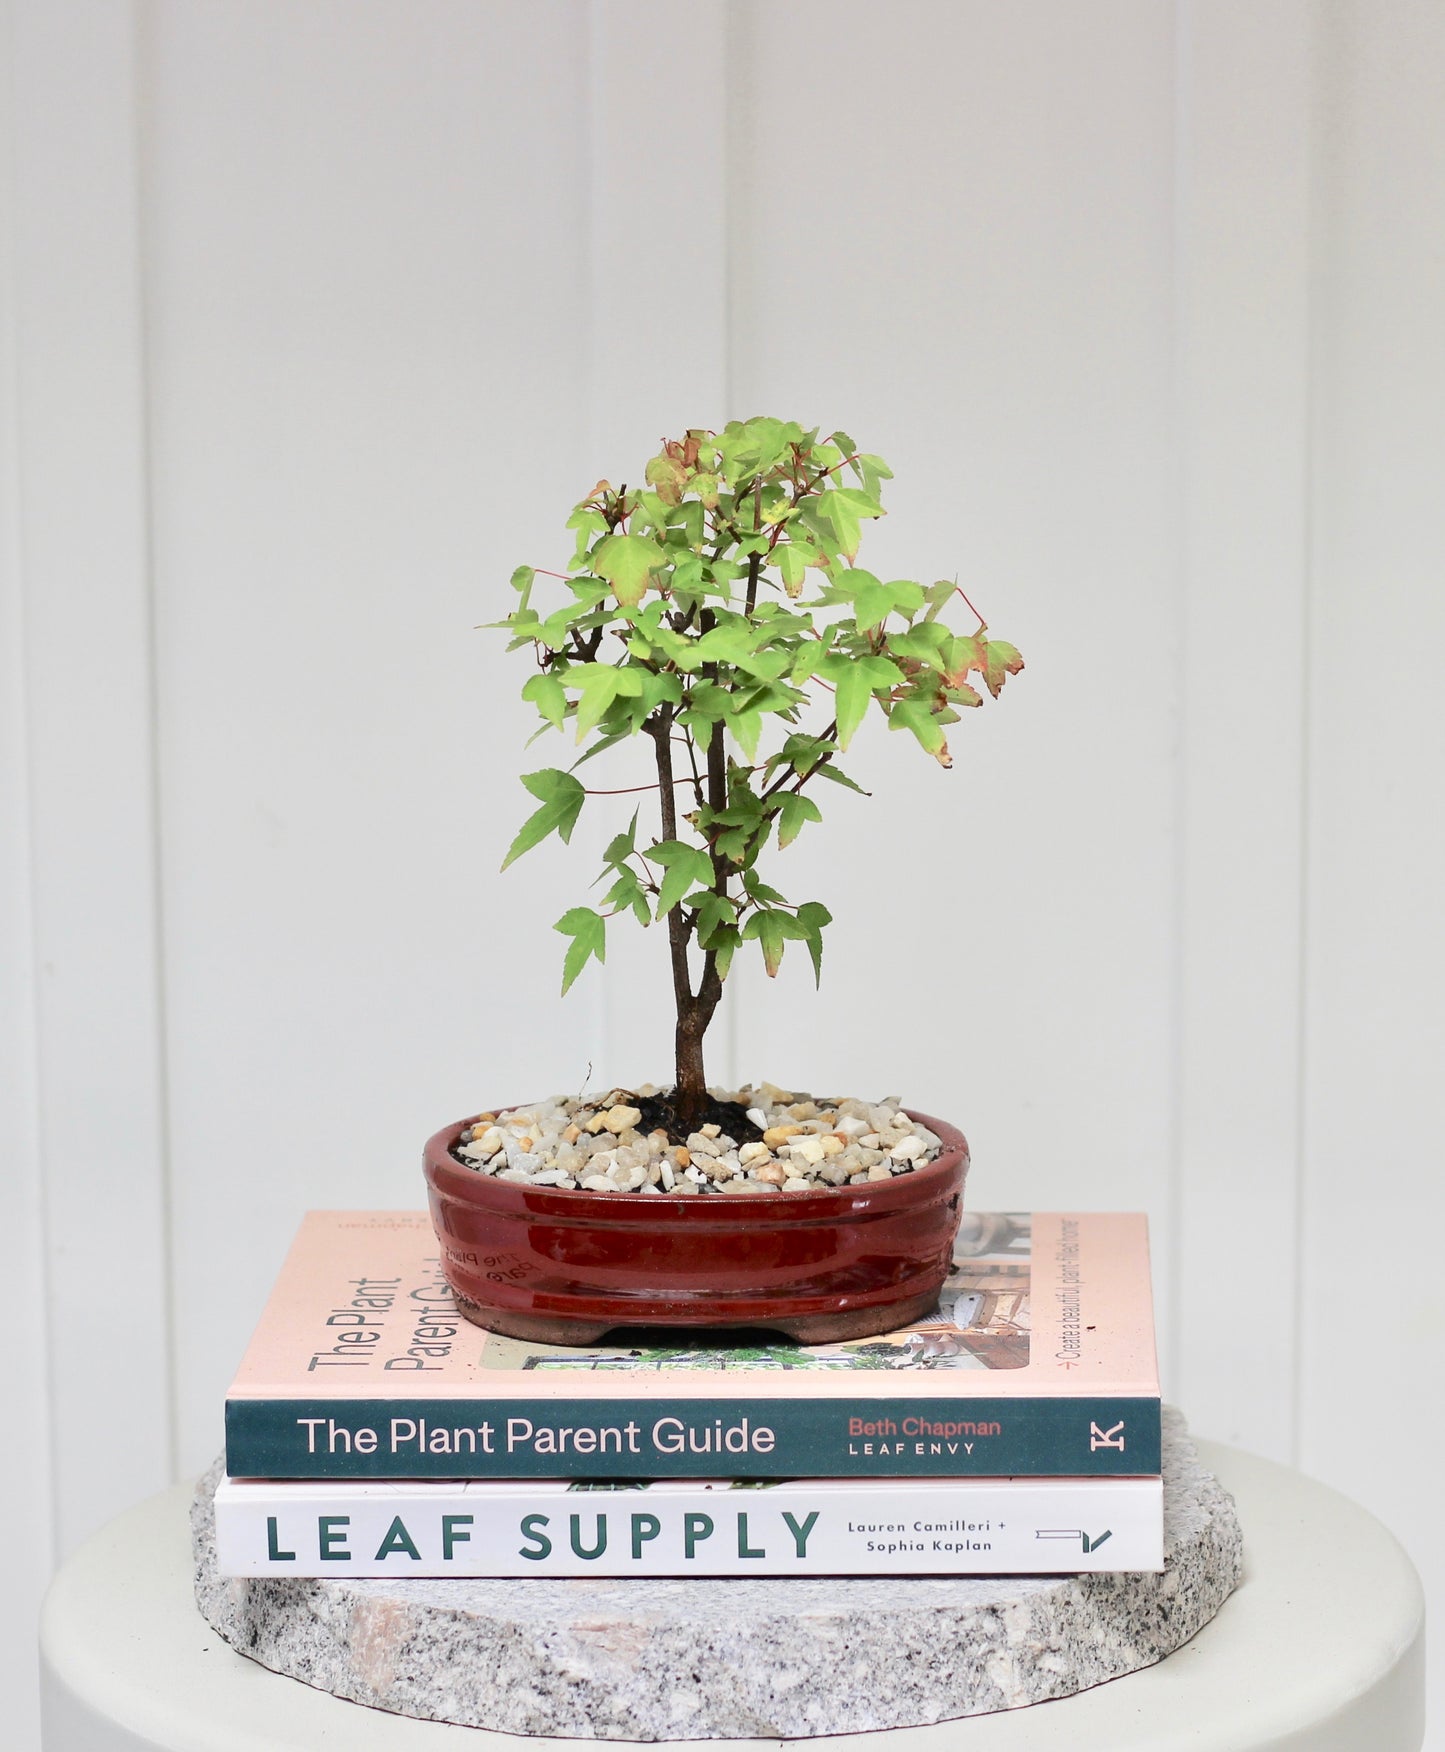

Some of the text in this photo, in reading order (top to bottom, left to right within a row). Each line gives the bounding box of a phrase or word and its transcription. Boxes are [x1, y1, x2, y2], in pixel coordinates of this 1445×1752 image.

[326, 1277, 402, 1326] Plant
[1055, 1285, 1082, 1323] beautiful,
[307, 1332, 381, 1372] The
[383, 1305, 462, 1371] Parent
[1055, 1331, 1081, 1360] Create
[297, 1417, 775, 1454] The Plant Parent Guide
[849, 1417, 1001, 1439] Beth Chapman
[1090, 1420, 1125, 1452] K
[849, 1442, 974, 1455] LEAF ENVY
[266, 1511, 820, 1561] LEAF SUPPLY
[848, 1521, 906, 1533] Lauren
[913, 1519, 990, 1532] Camilleri
[867, 1539, 992, 1555] Sophia Kaplan
